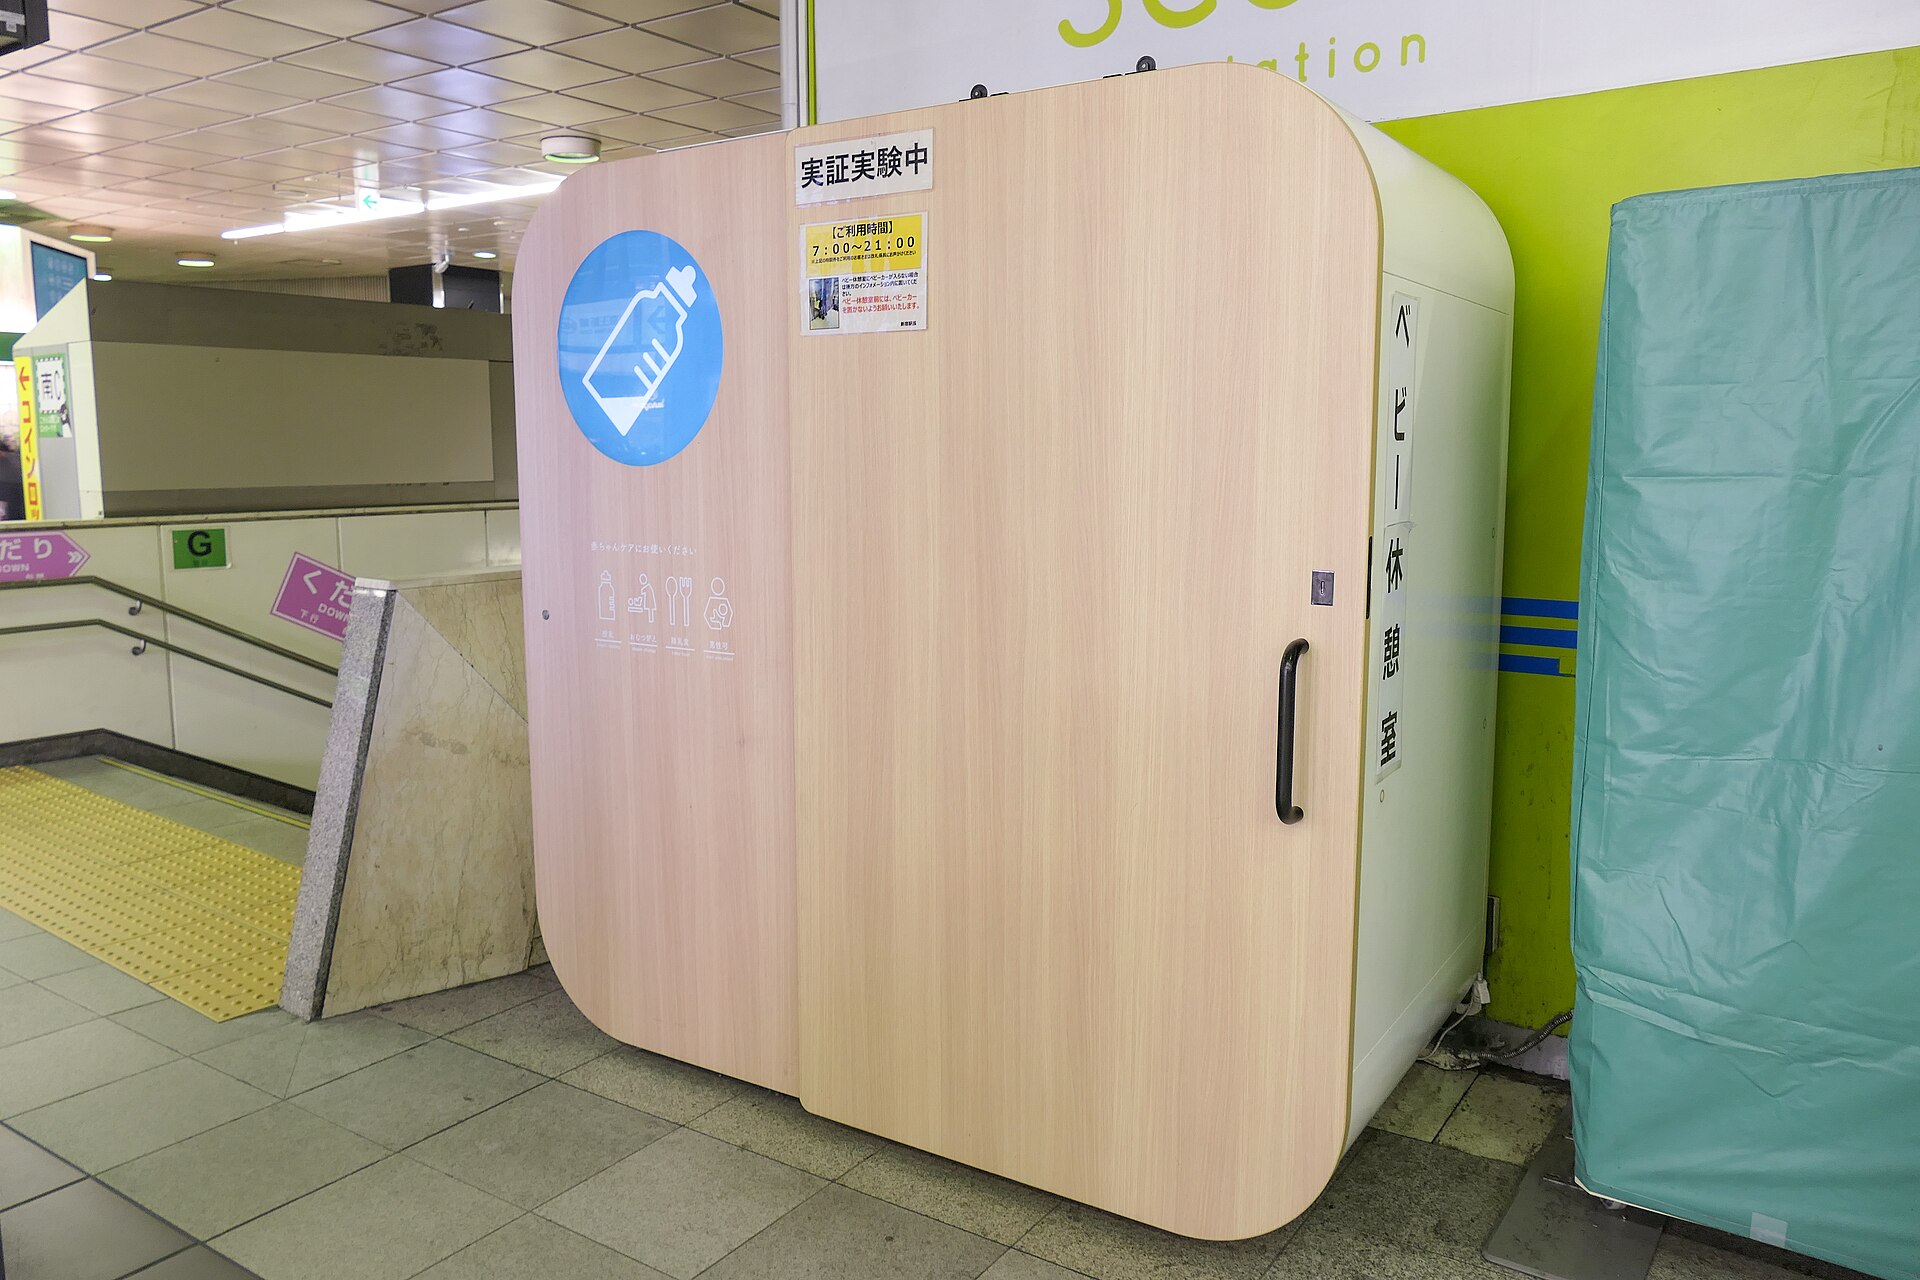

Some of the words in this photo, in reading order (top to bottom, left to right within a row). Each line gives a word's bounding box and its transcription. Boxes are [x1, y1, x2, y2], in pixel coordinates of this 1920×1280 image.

[1227, 33, 1426, 82] tion
[801, 142, 928, 188] 実証実験中
[832, 221, 893, 239] 【ご利用時間】
[188, 530, 212, 556] G
[1381, 304, 1412, 768] ベビー休憩室
